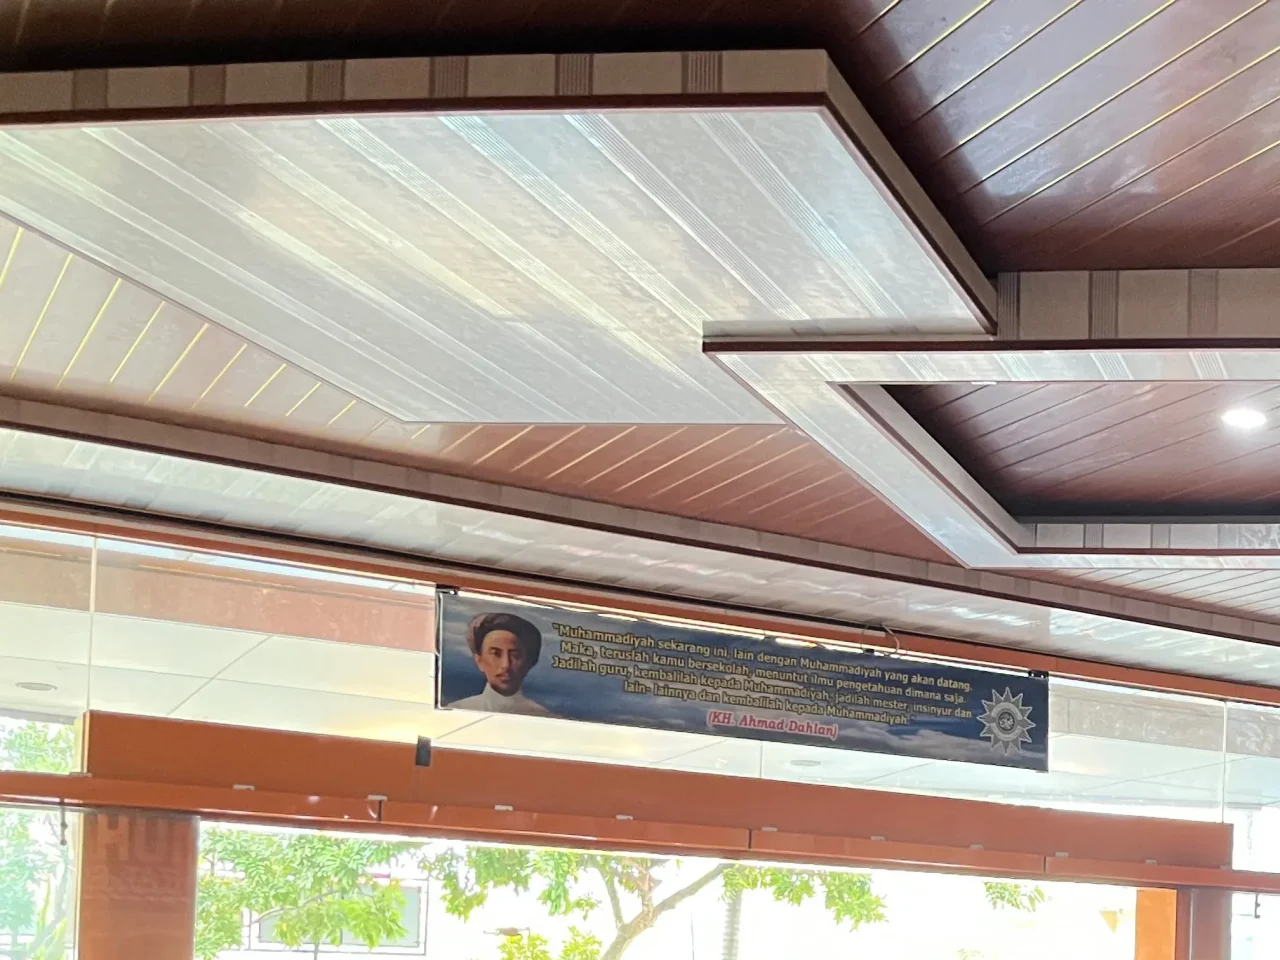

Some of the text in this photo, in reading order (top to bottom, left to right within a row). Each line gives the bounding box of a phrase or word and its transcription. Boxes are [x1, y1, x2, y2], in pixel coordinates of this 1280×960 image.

[560, 641, 598, 658] Maka,
[600, 646, 649, 662] teruslah
[652, 652, 685, 667] kamu
[688, 657, 753, 678] bersekolah,
[755, 668, 808, 683] menuntut
[810, 674, 834, 686] ilmu
[836, 680, 903, 697] pengetahuan
[905, 687, 942, 700] dimana
[657, 639, 710, 656] sekarang
[734, 648, 754, 661] lain
[757, 652, 797, 667] dengan
[800, 657, 882, 678] Muhammadiyah
[884, 671, 909, 684] yang
[911, 673, 935, 686] akan
[552, 656, 596, 672] Jadilah
[599, 664, 632, 679] guru,
[634, 665, 698, 685] kembalilah
[701, 676, 741, 690] kepada
[835, 692, 873, 706] jadilah
[873, 698, 911, 712] mester,
[913, 703, 952, 717] insinyur
[954, 707, 972, 718] dan
[624, 680, 652, 694] lain-
[654, 684, 696, 701] lainnya
[698, 689, 720, 702] dan
[722, 691, 783, 711] kembalilah
[785, 700, 824, 716] kepada
[708, 710, 838, 740] (KH. Ahmad Dahlan)
